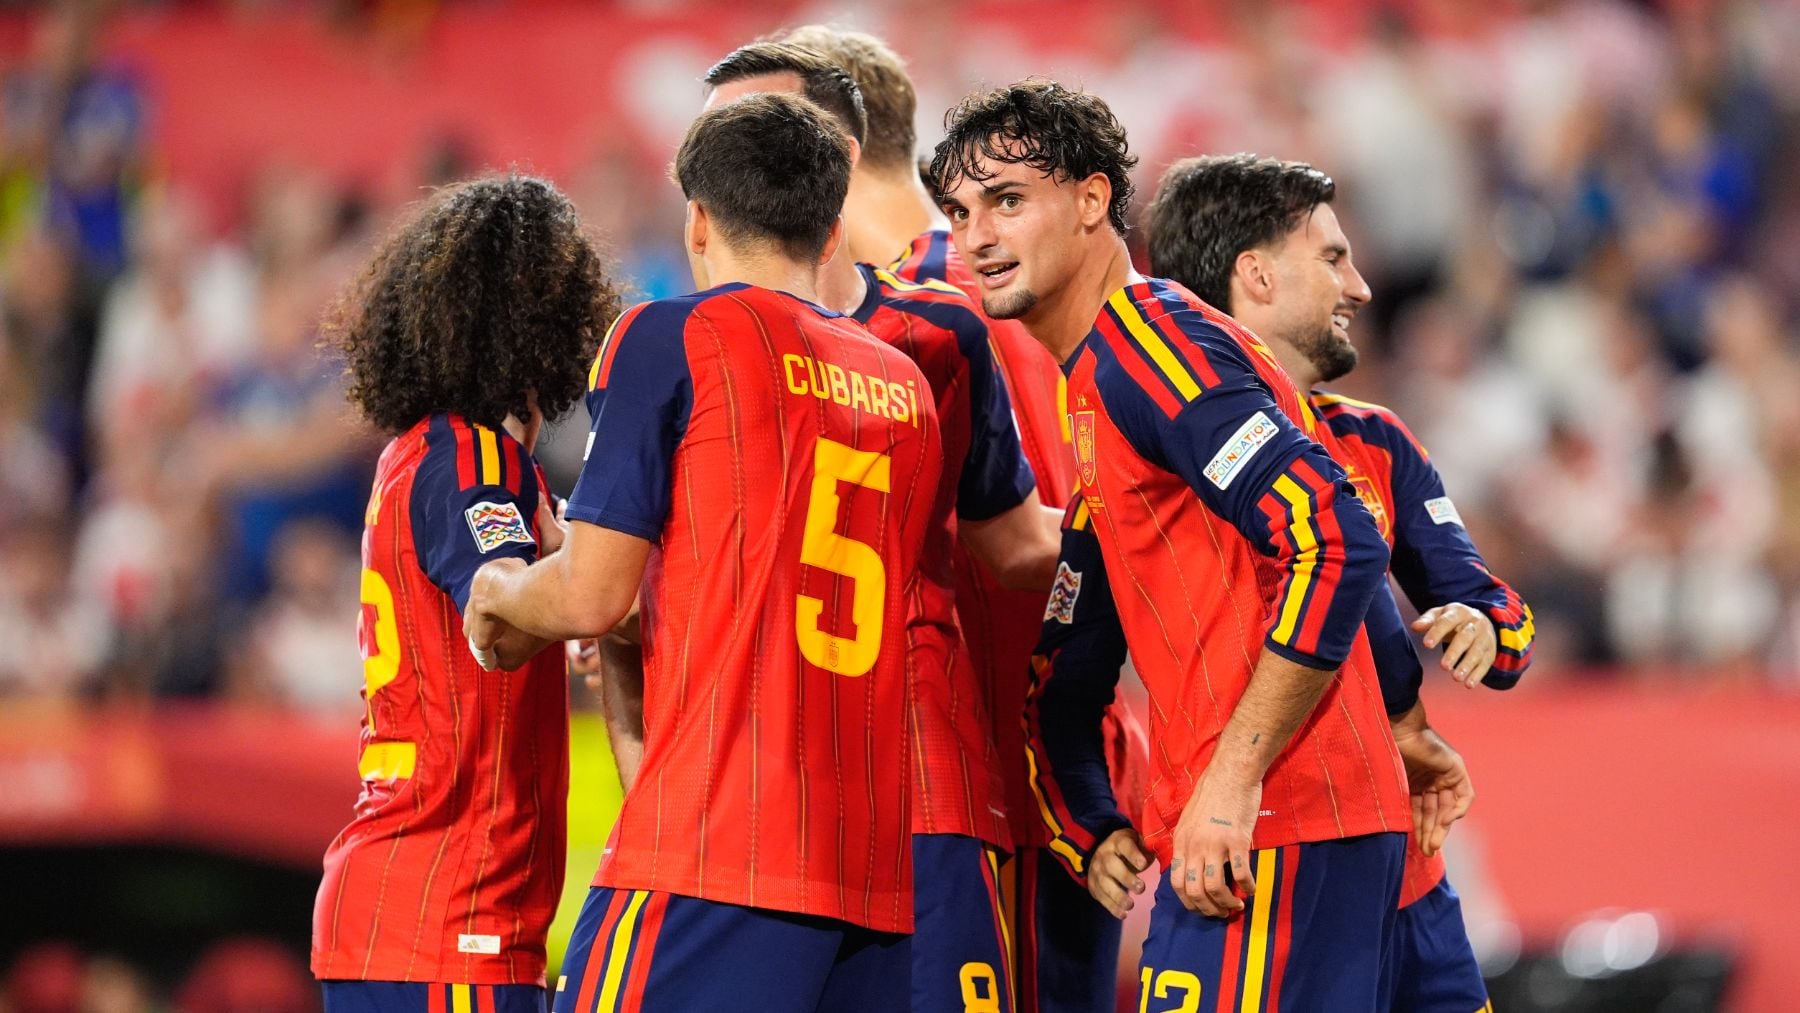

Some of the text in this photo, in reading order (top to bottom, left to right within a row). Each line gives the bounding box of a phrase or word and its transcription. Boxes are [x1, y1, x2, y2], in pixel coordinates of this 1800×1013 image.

[1211, 418, 1272, 483] FOUNDATION
[796, 436, 892, 678] 5
[959, 961, 1000, 1013] 8
